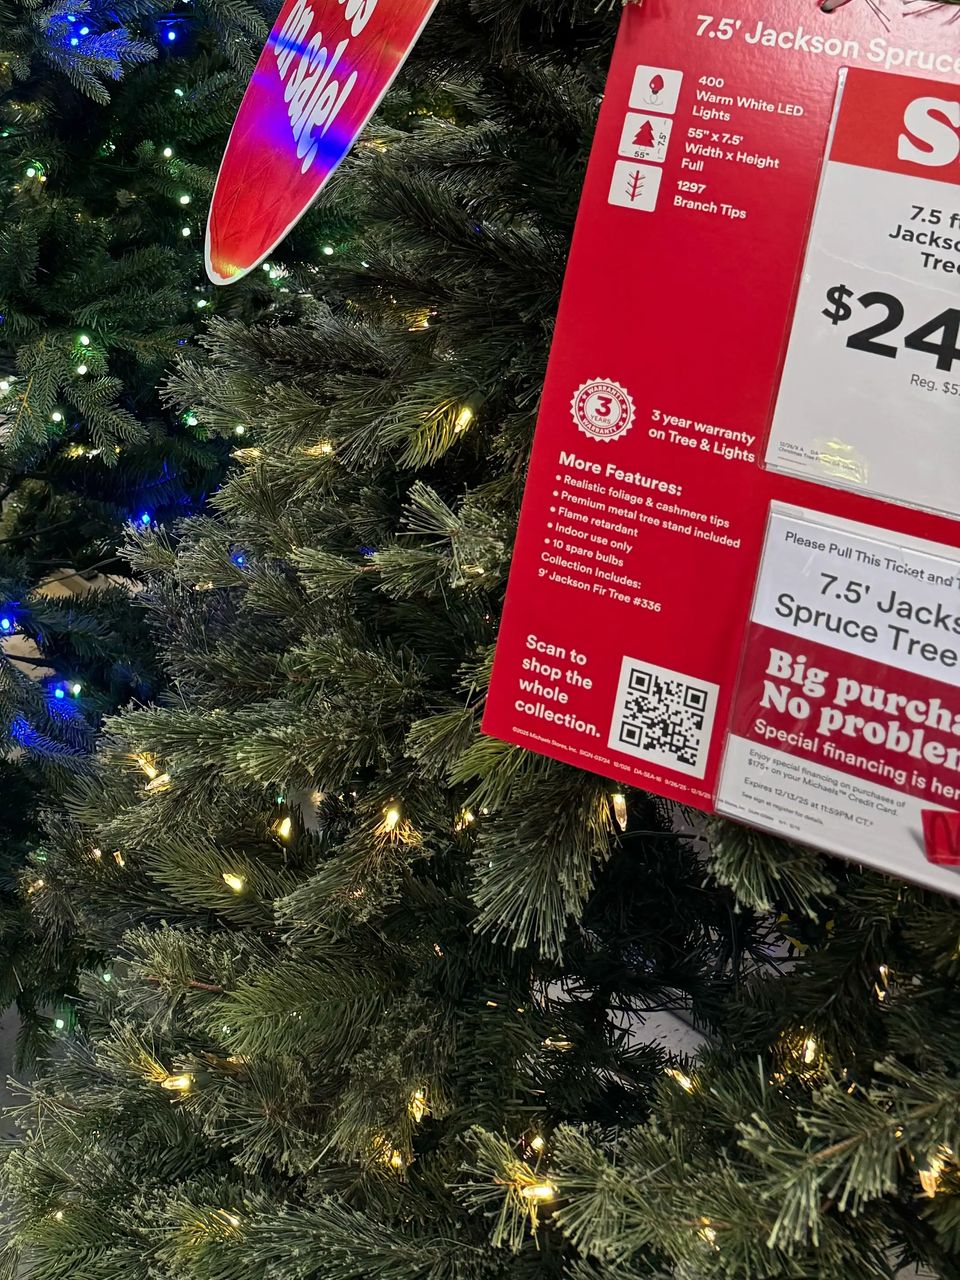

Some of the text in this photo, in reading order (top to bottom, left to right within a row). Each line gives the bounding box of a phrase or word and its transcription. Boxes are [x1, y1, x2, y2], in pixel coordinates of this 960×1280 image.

[696, 15, 741, 40] 7.5'
[745, 21, 859, 58] Jackson
[698, 76, 724, 88] 400
[286, 37, 358, 174] sale!
[692, 106, 730, 121] Lights
[696, 90, 804, 116] Warm White LED
[687, 128, 743, 145] 55" x 7.5'
[897, 96, 960, 167] S
[681, 159, 704, 172] Full
[684, 143, 780, 169] Width x Height
[677, 180, 706, 194] 1297
[673, 196, 747, 219] Branch Tips
[910, 205, 960, 229] 7.5 f
[920, 252, 960, 275] Tre
[587, 385, 623, 401] WARRANTY
[910, 373, 960, 396] Reg. $5
[590, 414, 611, 424] YEARS
[595, 395, 612, 416] 3
[583, 418, 617, 434] WARRANTY
[651, 409, 756, 446] 3 year warranty
[648, 428, 756, 463] on Tree & Lights
[559, 451, 683, 496] More Features:
[563, 475, 730, 528] Realistic foliage & cashmere tips
[558, 506, 639, 537] Flame retardant
[560, 491, 741, 549] Premium metal tree stand included
[552, 538, 624, 567] 10 spare bulbs
[555, 522, 633, 554] Indoor use only
[541, 551, 642, 589] Collection Includes:
[785, 531, 826, 551] Please
[828, 543, 853, 559] Pull
[855, 550, 881, 567] This
[884, 558, 925, 579] Ticket
[927, 572, 954, 587] and
[549, 571, 590, 591] Jackson
[592, 584, 607, 596] Fir
[608, 588, 631, 603] Tree
[633, 597, 662, 612] #336
[820, 572, 871, 604] 7.5'
[775, 593, 958, 667] Spruce Tree
[526, 634, 588, 665] Scan to
[522, 657, 593, 690] shop the
[765, 648, 829, 698] Big
[519, 677, 568, 704] whole
[760, 680, 810, 719] No
[514, 699, 602, 738] collection.
[754, 719, 818, 753] Special
[823, 742, 906, 785] financing
[912, 770, 926, 788] is
[749, 749, 907, 808] Enjoy special financing on purchases of
[771, 767, 782, 775] on
[783, 771, 801, 783] your
[847, 793, 874, 808] Credit
[875, 803, 898, 816] Card.
[744, 777, 772, 793] Expires
[774, 786, 809, 806] 12/13/25
[810, 801, 819, 809] at
[820, 805, 854, 822] 11:59PM
